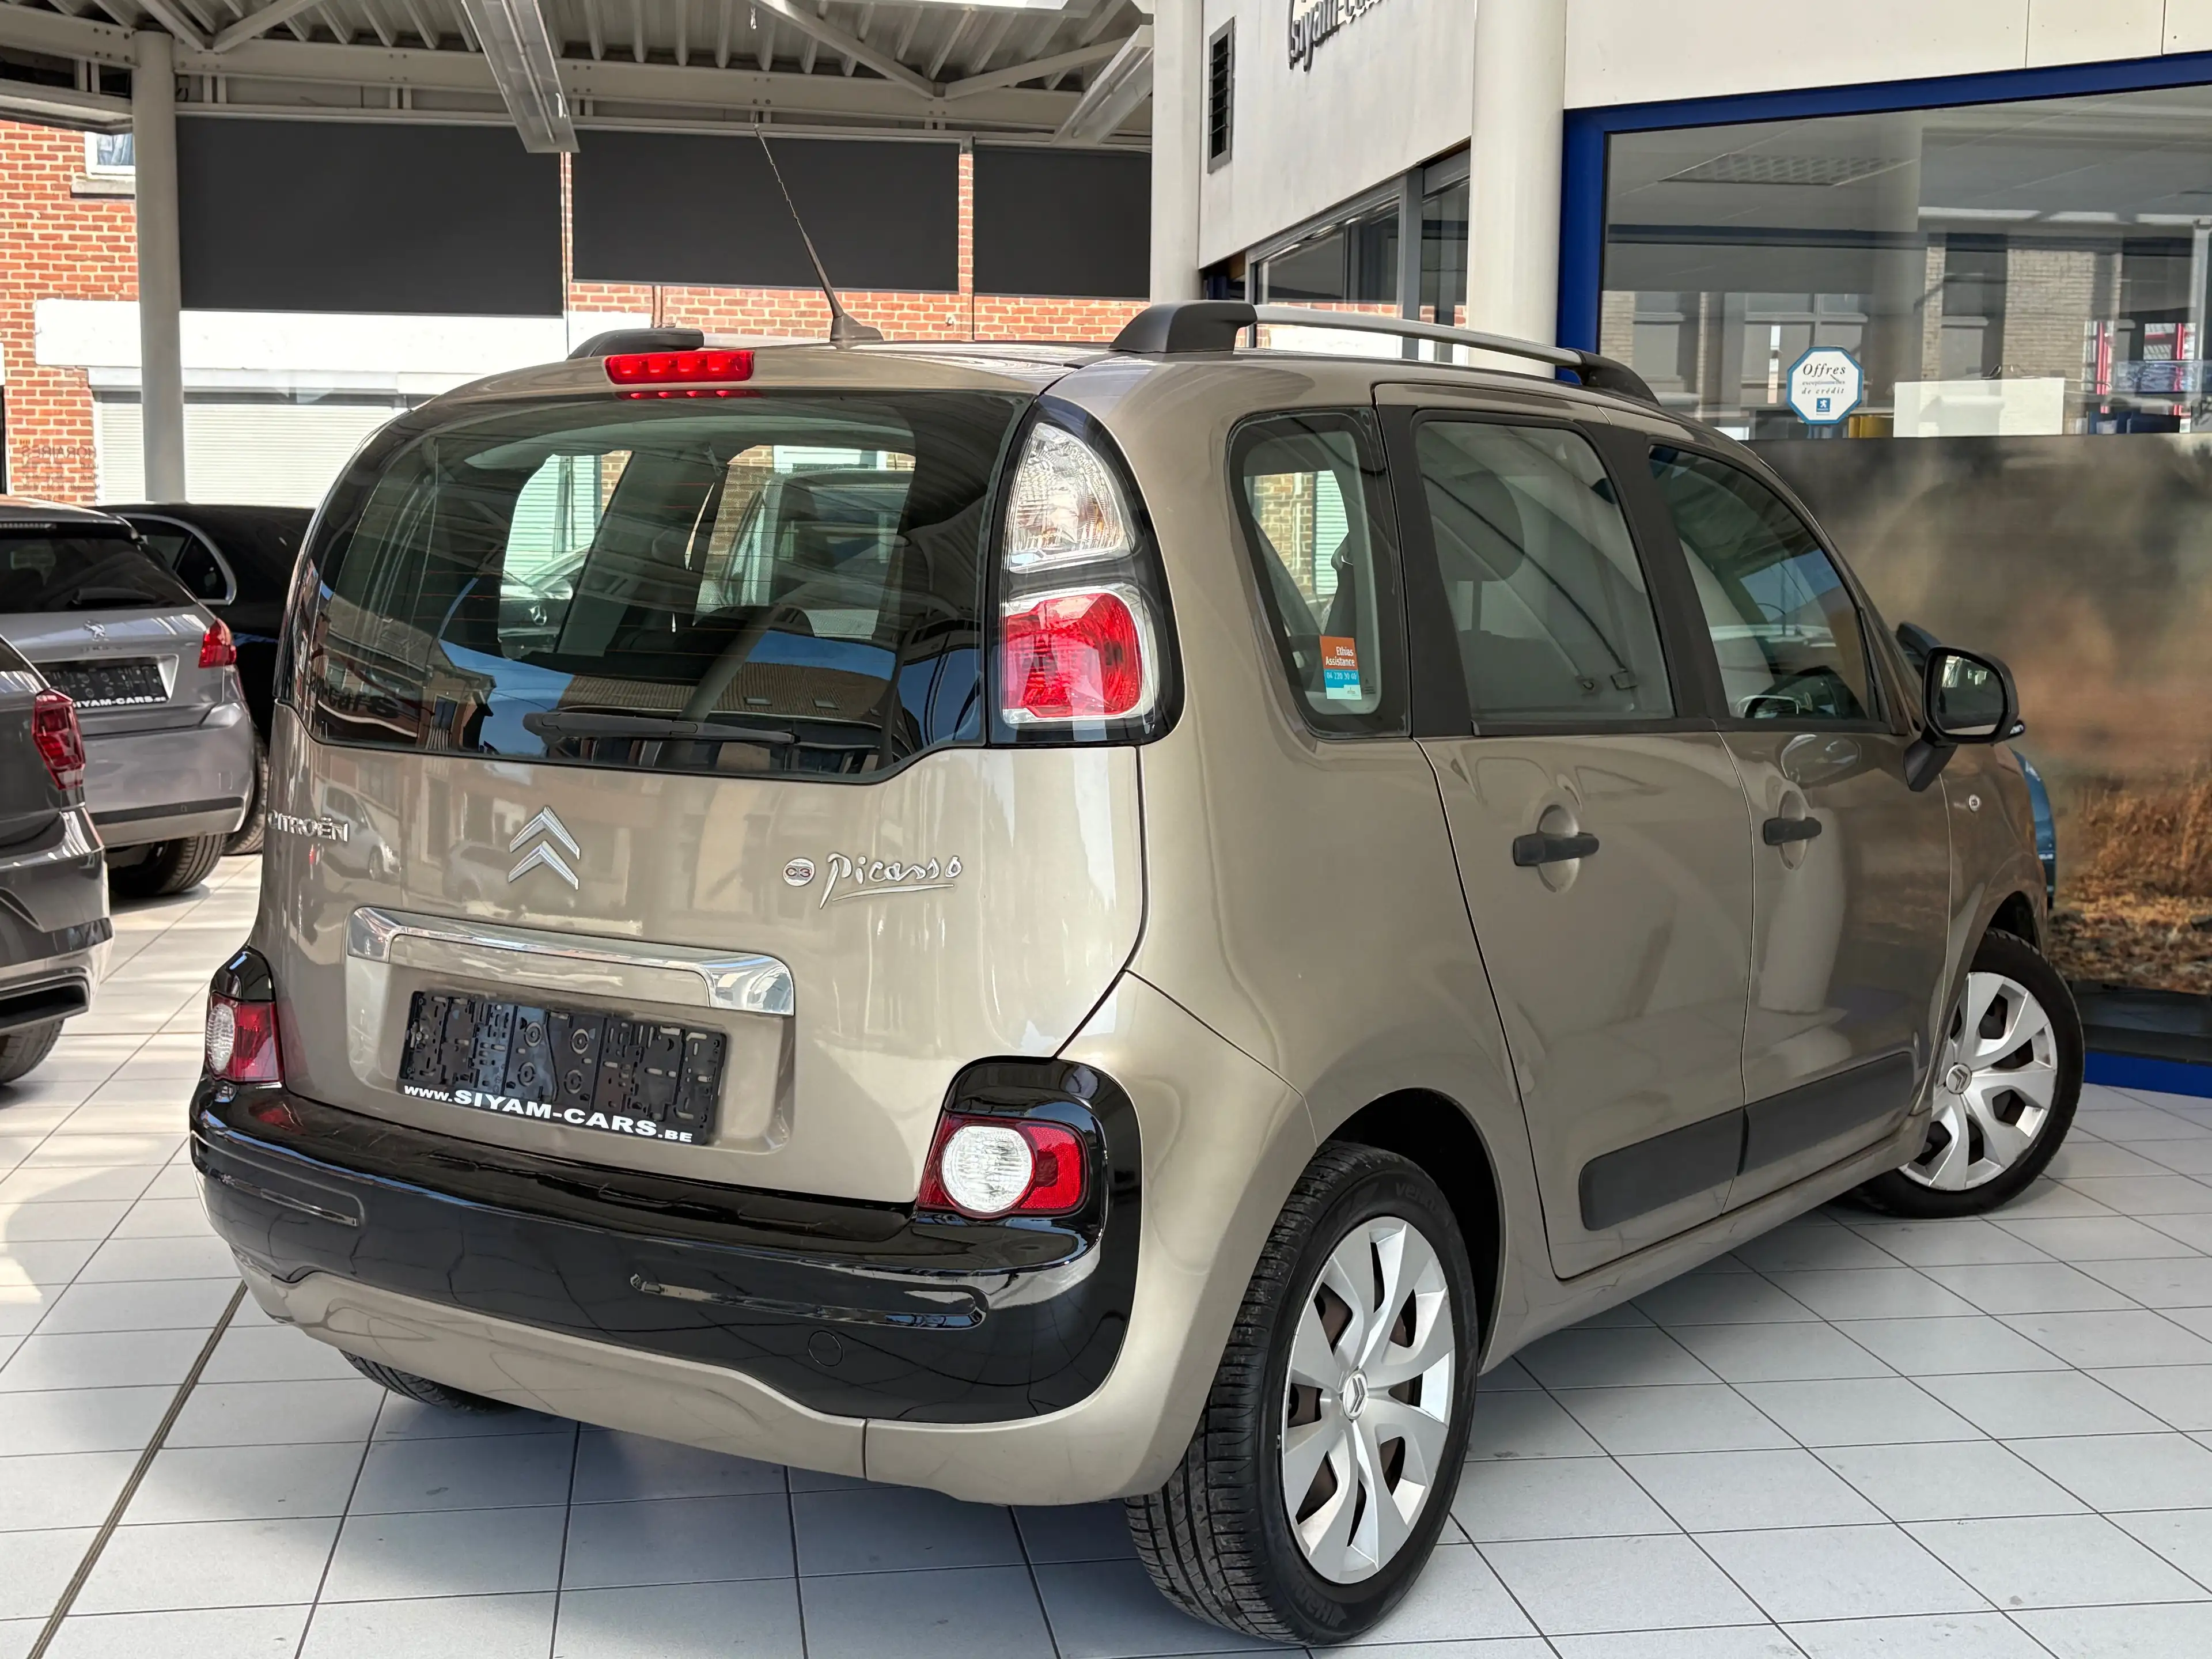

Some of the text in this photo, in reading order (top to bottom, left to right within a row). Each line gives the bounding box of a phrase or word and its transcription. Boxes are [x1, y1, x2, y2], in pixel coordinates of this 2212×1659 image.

[1802, 363, 1846, 377] Offres
[1325, 656, 1355, 666] Assistance
[267, 809, 350, 842] CITROËN
[820, 852, 963, 910] Picasso
[403, 1085, 693, 1143] www.SIYAM-CARS.BE
